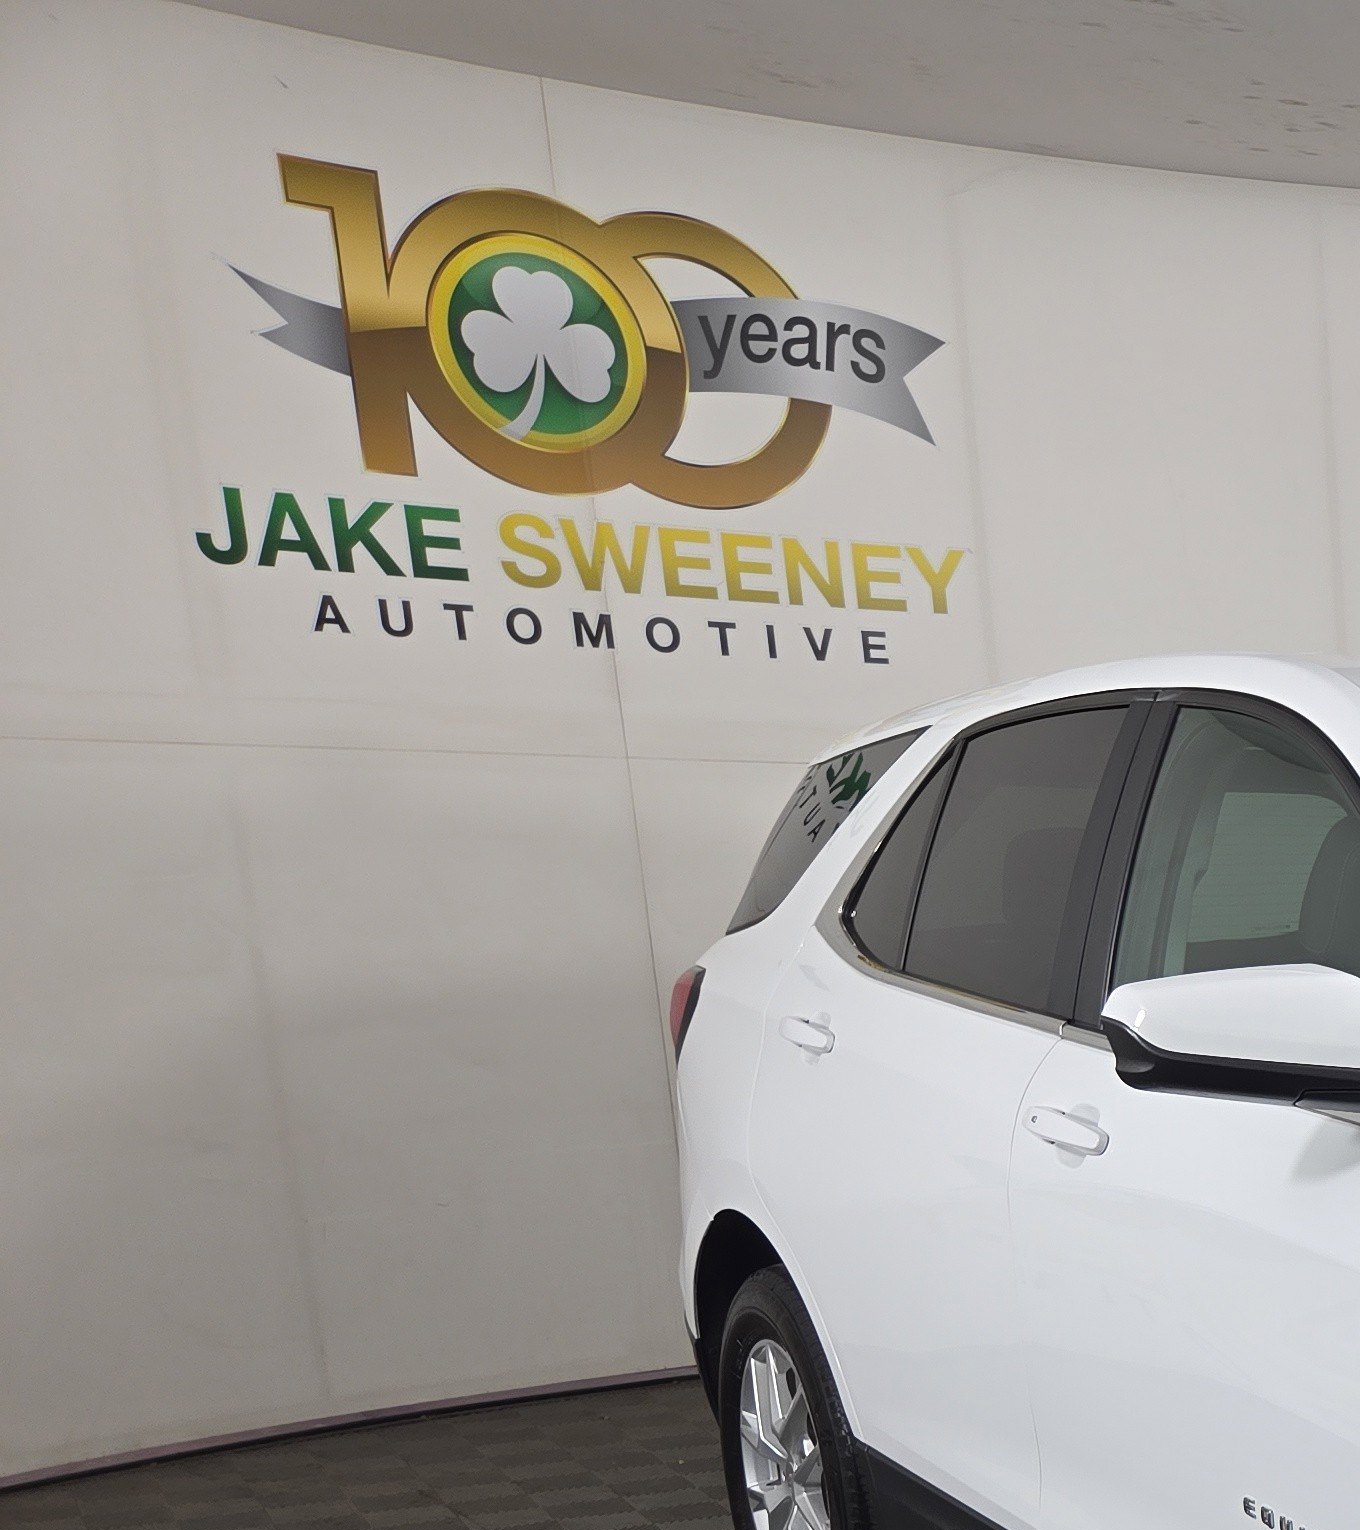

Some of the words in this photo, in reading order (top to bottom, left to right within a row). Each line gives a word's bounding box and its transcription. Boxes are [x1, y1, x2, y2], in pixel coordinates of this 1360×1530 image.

[277, 152, 835, 510] 100
[697, 313, 887, 384] years
[196, 486, 470, 583] JAKE
[498, 512, 966, 615] SWEENEY
[313, 594, 891, 665] AUTOMOTIVE
